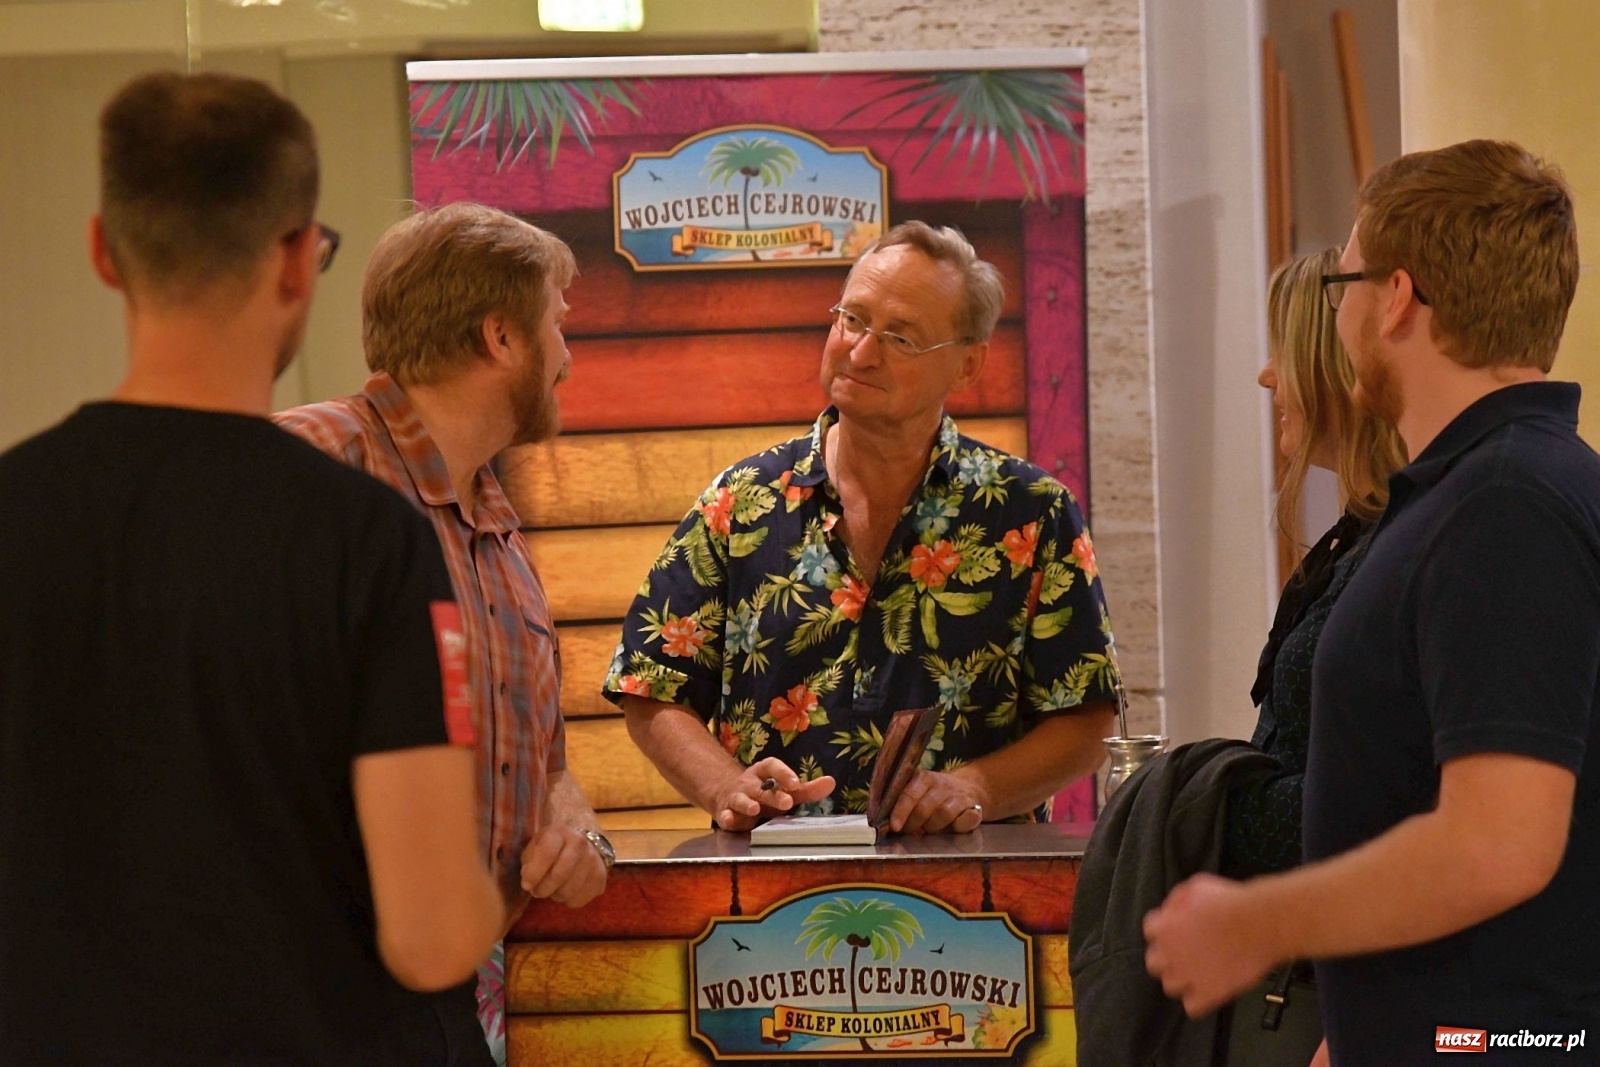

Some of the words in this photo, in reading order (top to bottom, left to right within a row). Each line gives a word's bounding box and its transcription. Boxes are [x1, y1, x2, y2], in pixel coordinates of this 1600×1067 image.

[625, 193, 740, 230] WOJCIECH
[750, 193, 879, 223] CEJROWSKI
[691, 229, 732, 247] SKLEP
[736, 226, 815, 247] KOLONIALNY
[702, 967, 846, 1010] WOJCIECH
[858, 967, 1021, 1008] CEJROWSKI
[784, 1010, 836, 1032] SKLEP
[840, 1009, 941, 1034] KOLONIALNY
